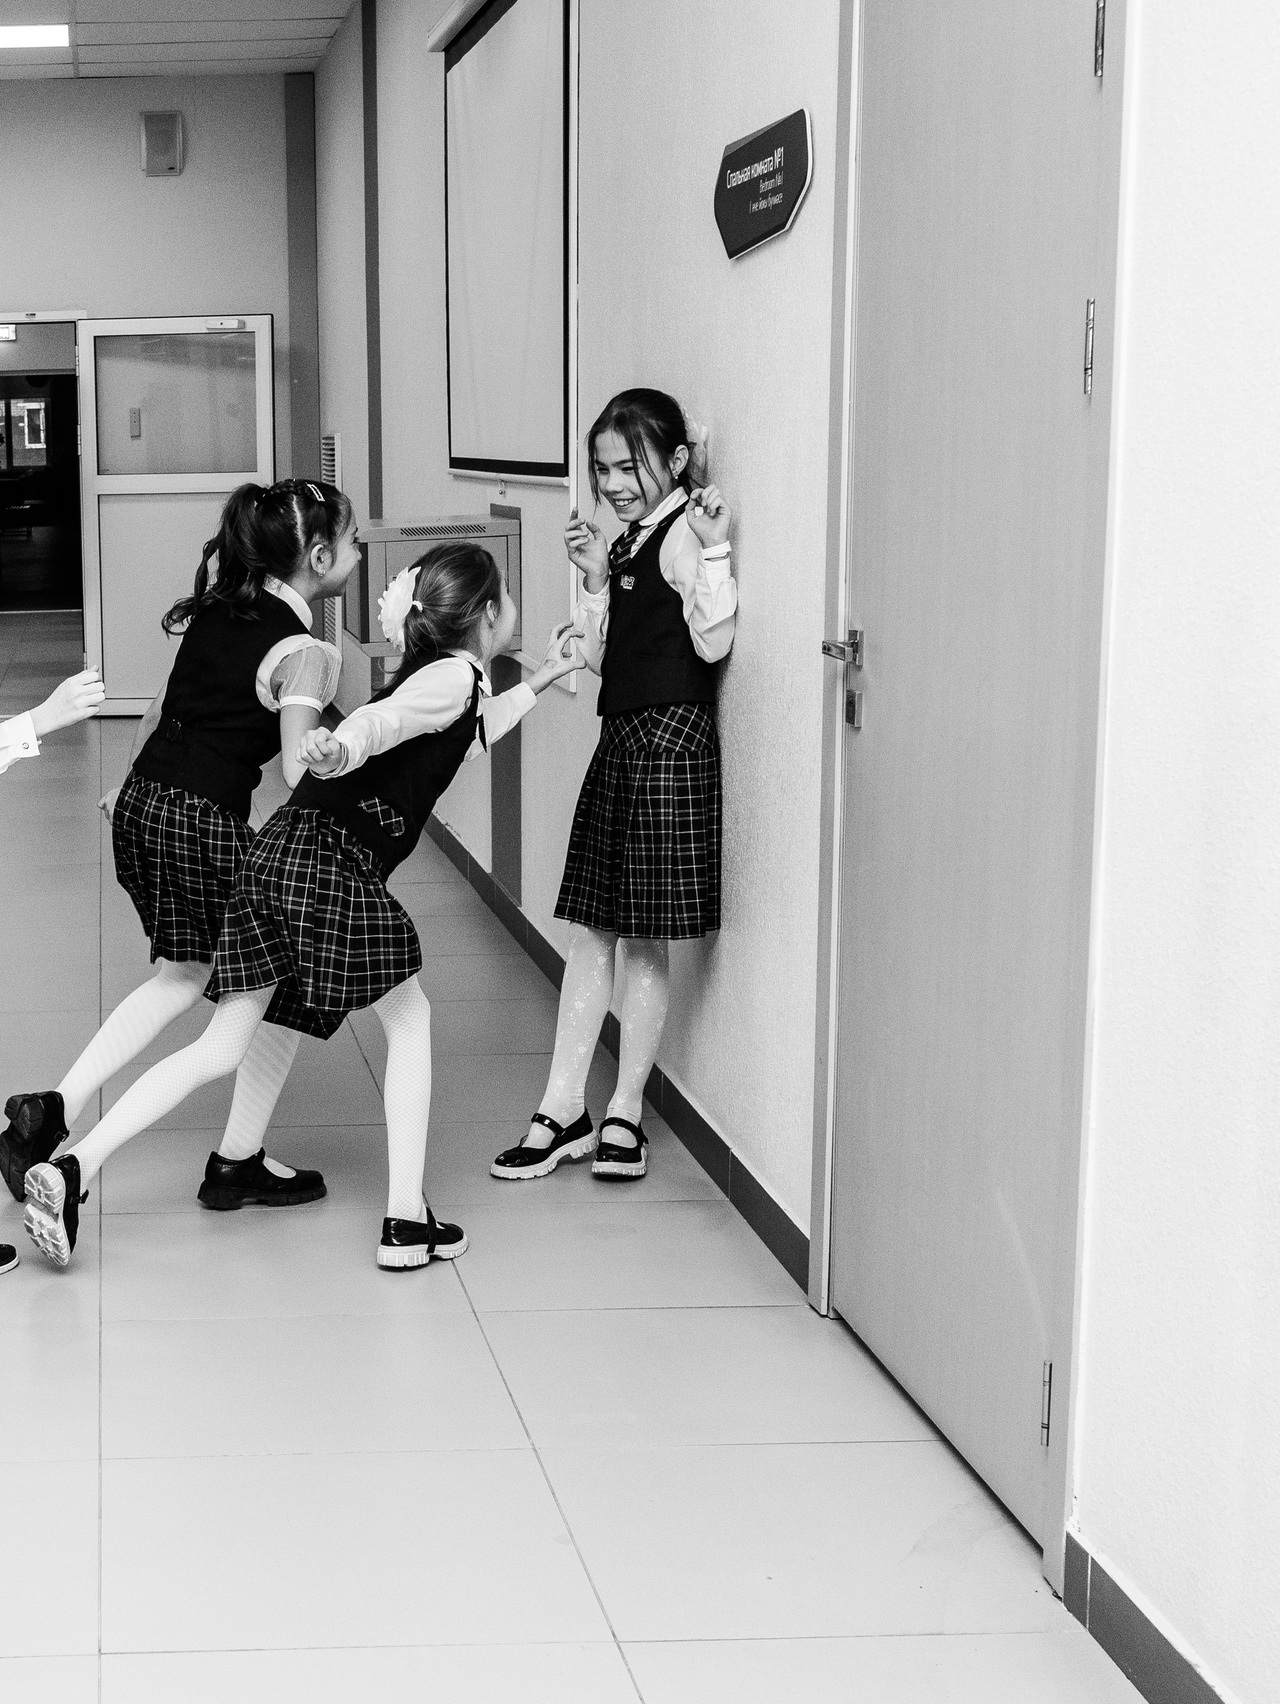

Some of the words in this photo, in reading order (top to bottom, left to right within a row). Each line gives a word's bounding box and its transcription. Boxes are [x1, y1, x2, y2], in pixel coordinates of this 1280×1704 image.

[726, 166, 750, 188] Спальная
[751, 156, 773, 180] комната
[774, 146, 784, 169] №1
